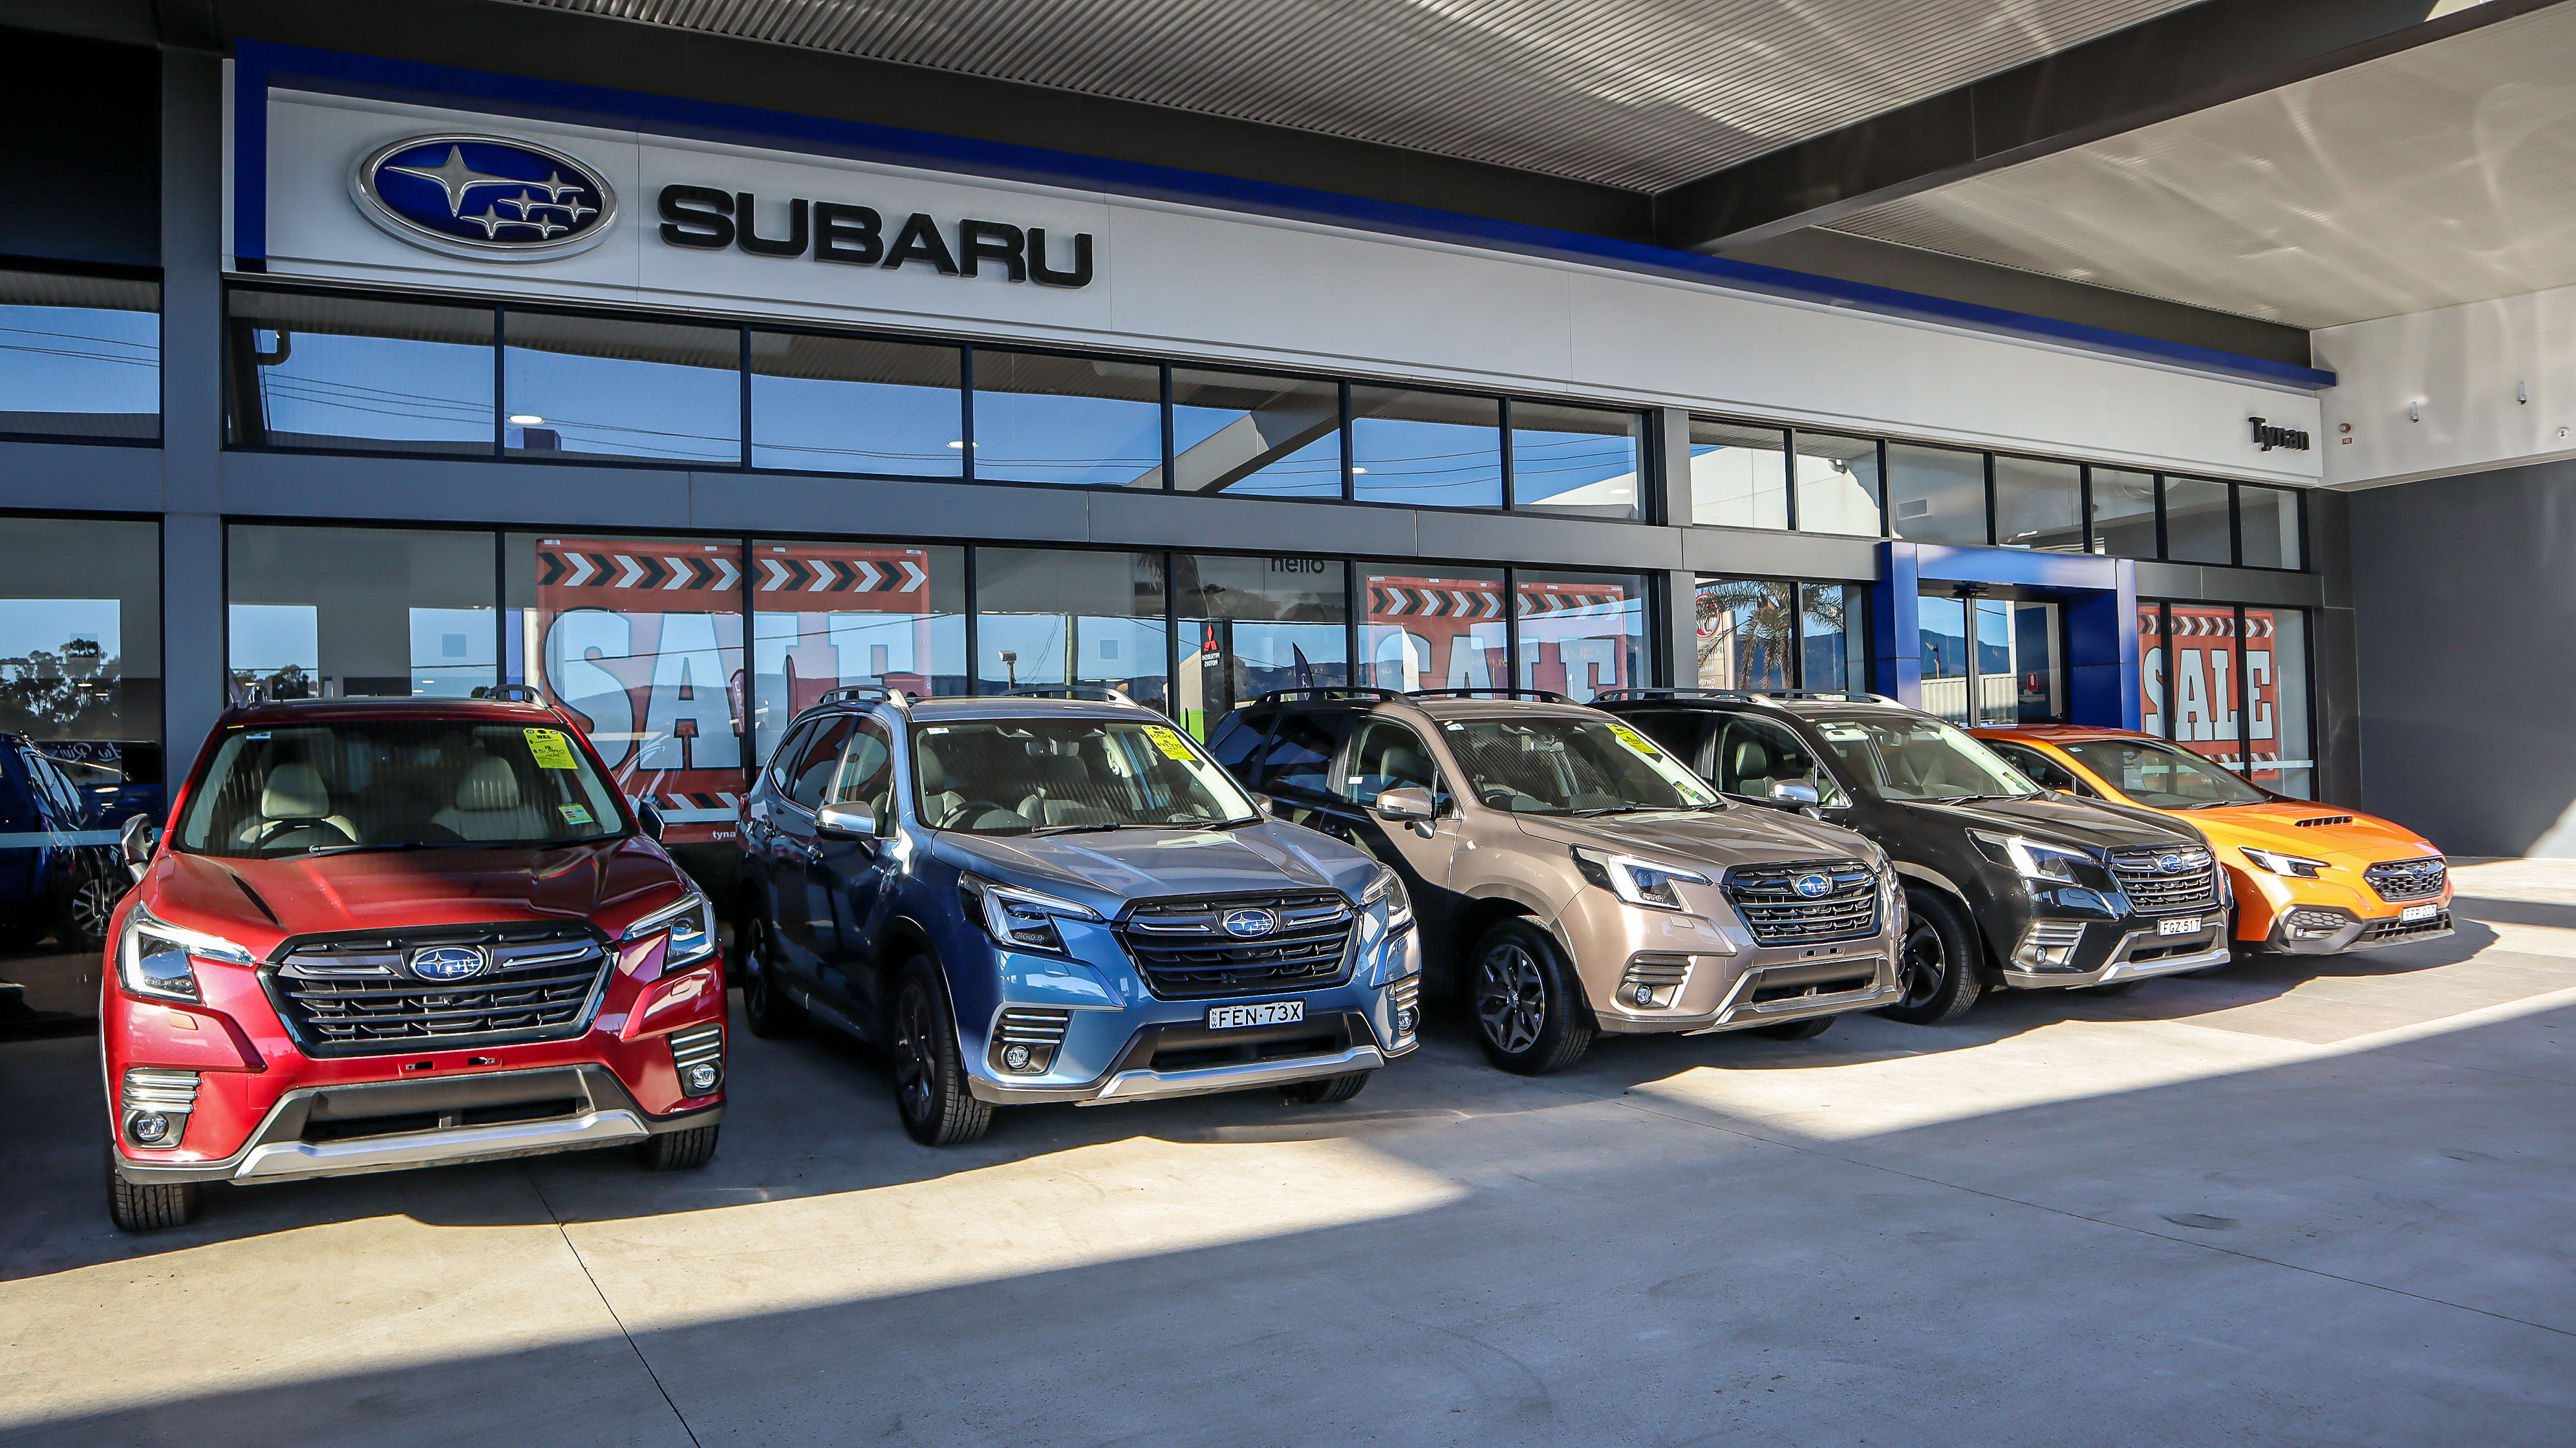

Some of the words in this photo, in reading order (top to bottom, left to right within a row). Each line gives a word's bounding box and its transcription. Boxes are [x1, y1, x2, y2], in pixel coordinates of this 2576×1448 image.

[658, 184, 1093, 288] SUBARU
[2248, 417, 2310, 452] Tynan
[2143, 646, 2273, 741] SALE
[713, 831, 736, 840] tyna
